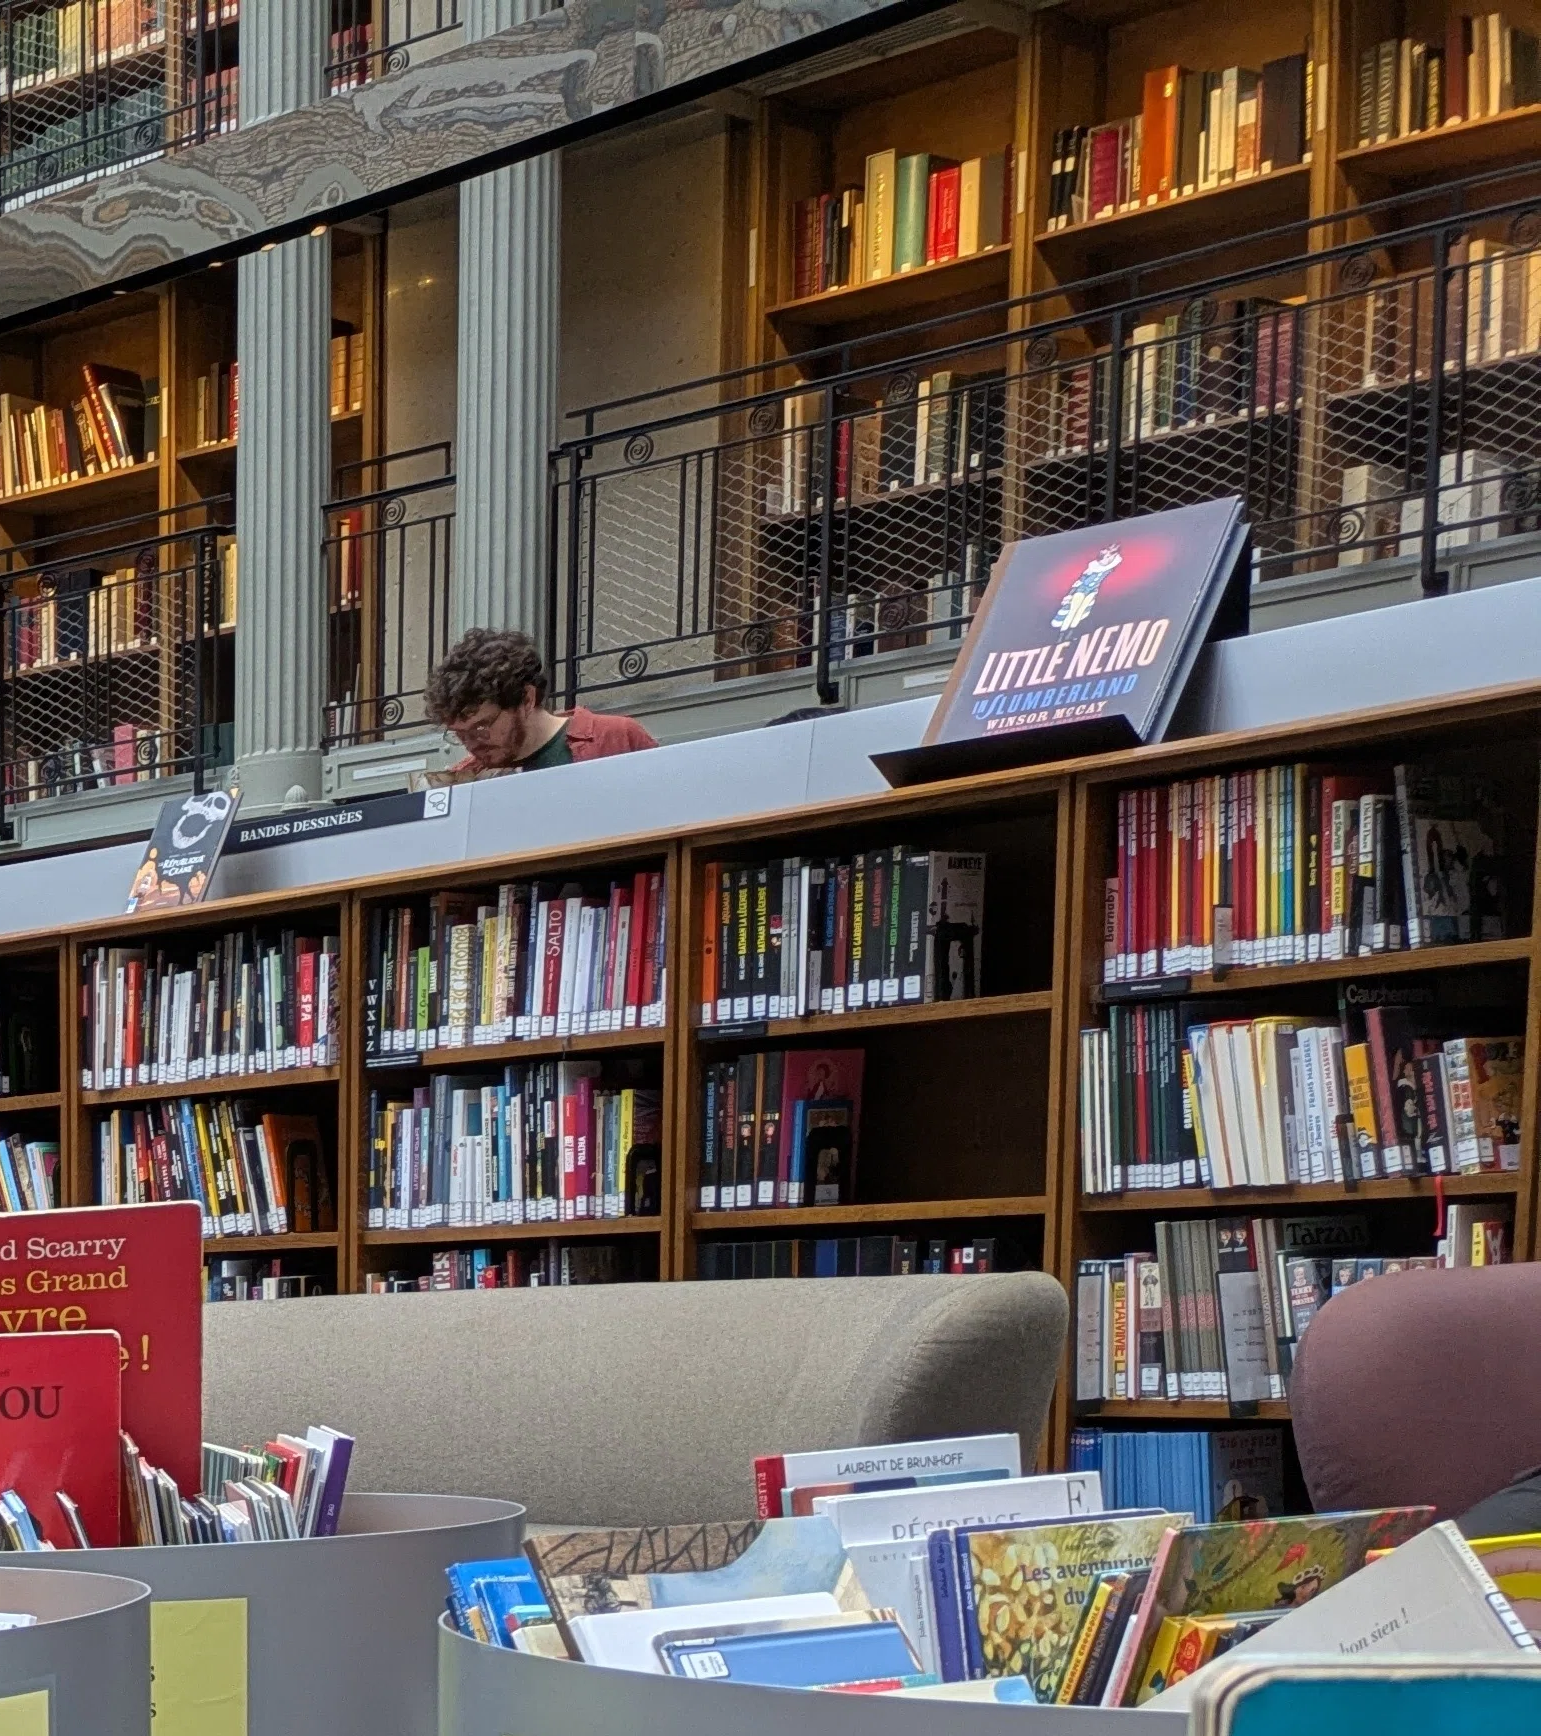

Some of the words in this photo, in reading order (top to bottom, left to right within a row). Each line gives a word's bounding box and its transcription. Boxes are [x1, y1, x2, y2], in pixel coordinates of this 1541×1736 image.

[973, 641, 1070, 695] LITTLE
[1065, 618, 1169, 680] NEMO
[977, 673, 1138, 720] SLUMBERLAND
[986, 711, 1048, 731] WINSOR
[239, 822, 291, 843] BANDES
[291, 810, 363, 834] DESSINÉES
[948, 857, 983, 870] HAWKEYE
[1105, 887, 1118, 943] Barnaby
[545, 909, 563, 957] SALTO
[738, 928, 747, 955] BATMAN
[757, 926, 766, 953] BATMAN
[451, 928, 468, 984] BOUQUET
[368, 979, 378, 991] V
[299, 994, 313, 1024] SPA
[367, 995, 379, 1006] W
[367, 1009, 377, 1022] X
[367, 1025, 375, 1037] Y
[367, 1041, 375, 1052] Z
[27, 1236, 126, 1261] Scarry
[26, 1265, 128, 1293] Grand
[837, 1459, 887, 1476] LAURENT
[890, 1458, 904, 1471] DE
[906, 1451, 965, 1469] BRUNHOFF
[757, 1471, 768, 1518] CHETTE
[1021, 1563, 1052, 1583] Les
[1063, 1586, 1085, 1606] du
[1370, 1617, 1401, 1644] sien
[1077, 1658, 1097, 1701] ANTHONY
[1095, 1619, 1112, 1658] BROWNE
